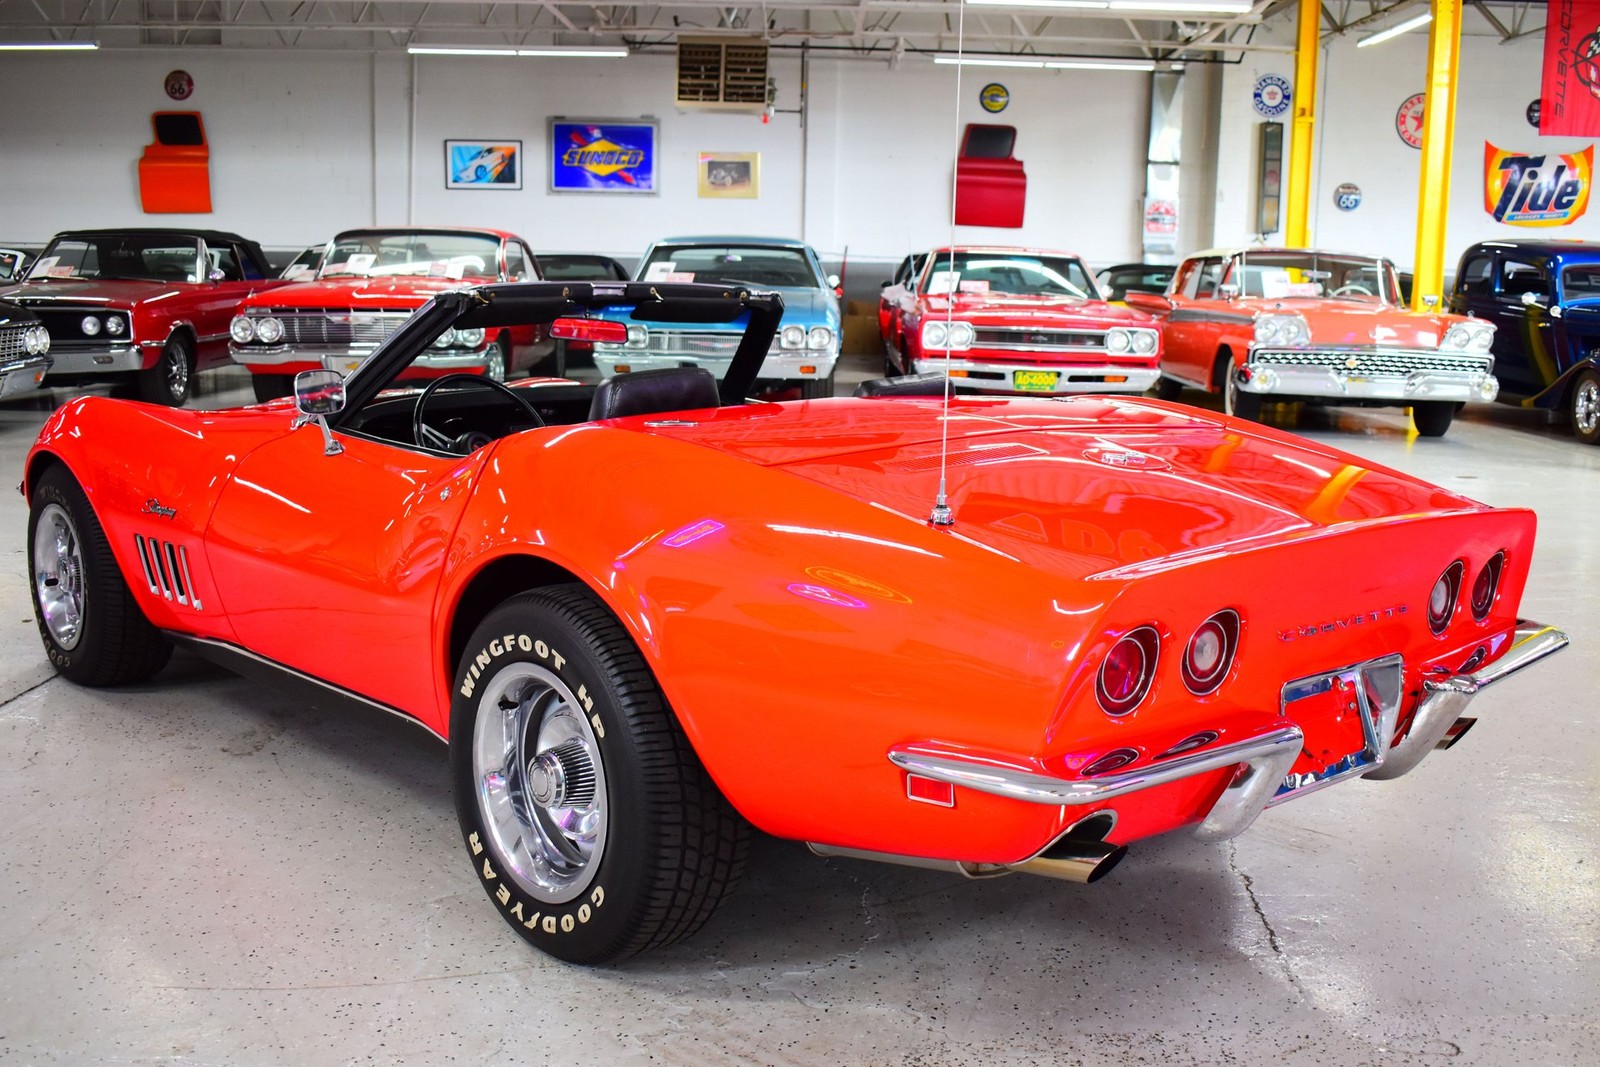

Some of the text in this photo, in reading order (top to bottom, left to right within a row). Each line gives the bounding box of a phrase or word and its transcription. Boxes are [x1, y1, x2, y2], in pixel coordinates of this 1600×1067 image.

[1554, 0, 1573, 118] CORVETTE
[170, 83, 185, 95] 66
[1253, 76, 1291, 93] STANDARD
[1253, 97, 1290, 116] GASOLINE
[564, 149, 643, 167] SUNOCO
[1339, 193, 1357, 209] 66
[1493, 155, 1579, 223] Tide
[1278, 605, 1408, 642] CORVETTE
[460, 634, 606, 739] WINGFOOT HP
[469, 831, 605, 934] GOODYEAR
